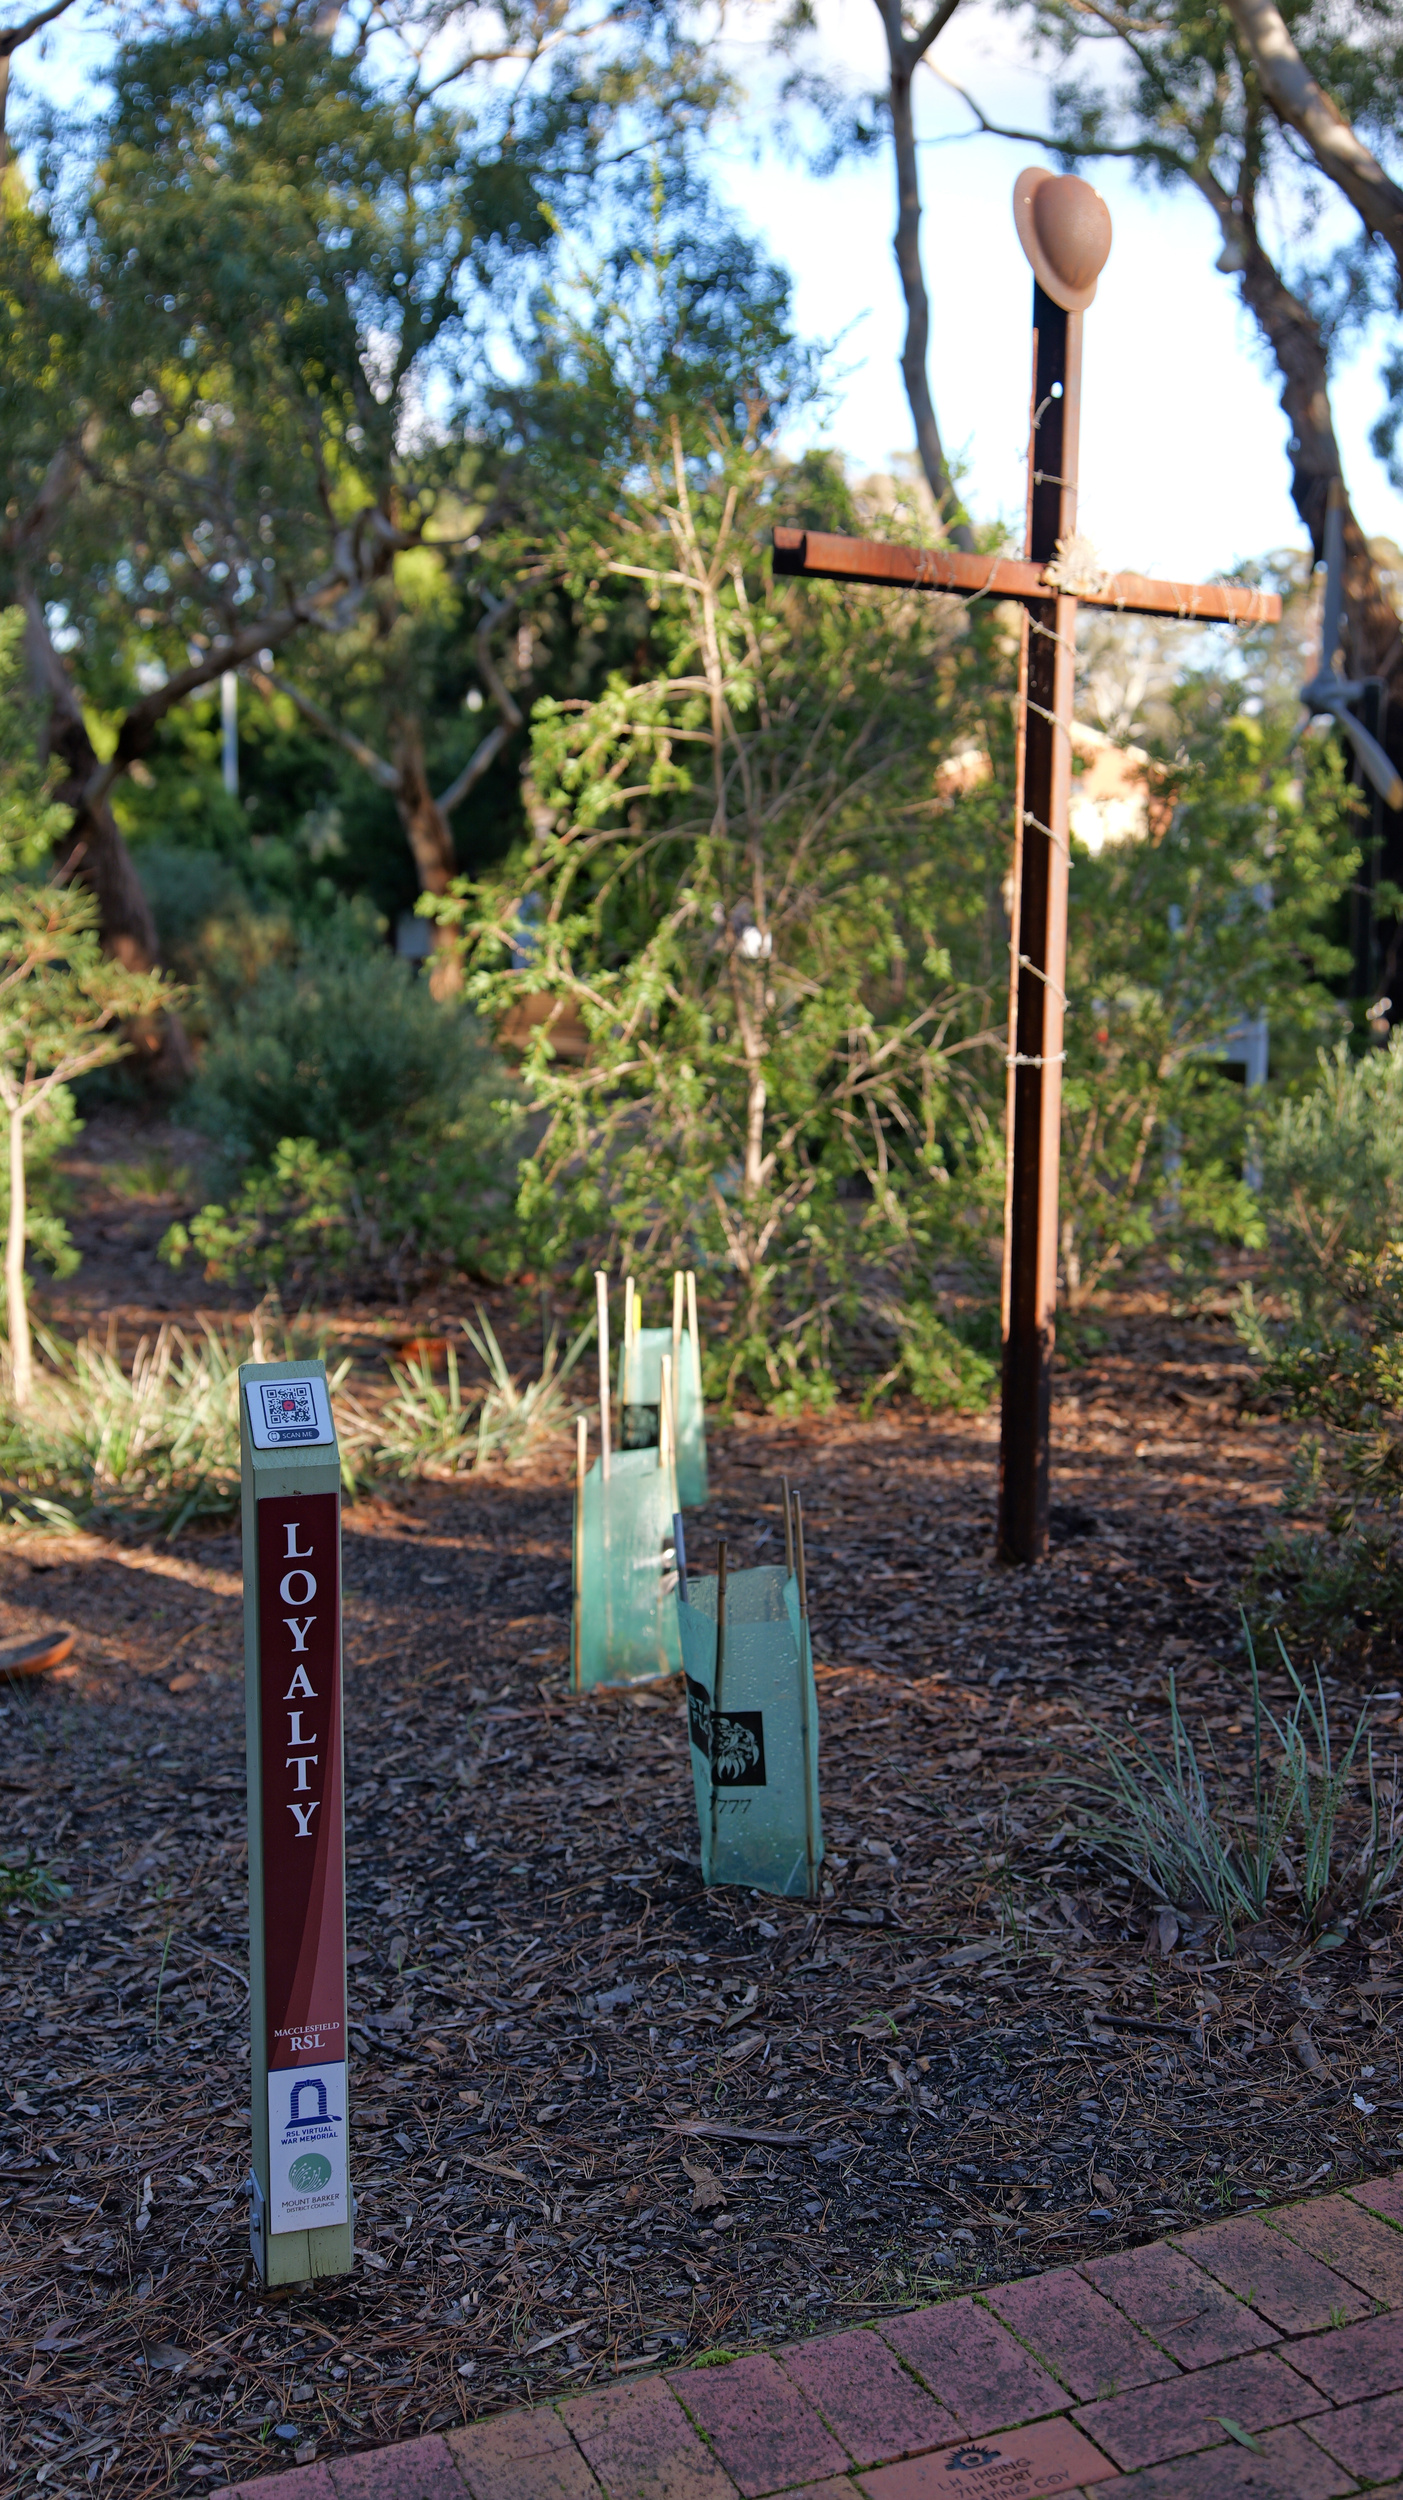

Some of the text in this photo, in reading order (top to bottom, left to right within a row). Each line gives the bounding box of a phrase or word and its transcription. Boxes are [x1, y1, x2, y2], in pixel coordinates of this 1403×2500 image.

[282, 1430, 313, 1439] SCAN ME
[279, 1522, 320, 1838] LOYALTY
[274, 2021, 340, 2037] MACCLESFIELD
[290, 2033, 326, 2052] RSL
[281, 2132, 338, 2146] WAR MEMORIAL
[286, 2125, 333, 2138] RSL VIRTUAL
[281, 2193, 340, 2208] MOUNT BARKER
[286, 2201, 335, 2213] DISTRICT COUNCIL
[987, 2469, 1034, 2490] PORT
[1033, 2470, 1070, 2489] COY
